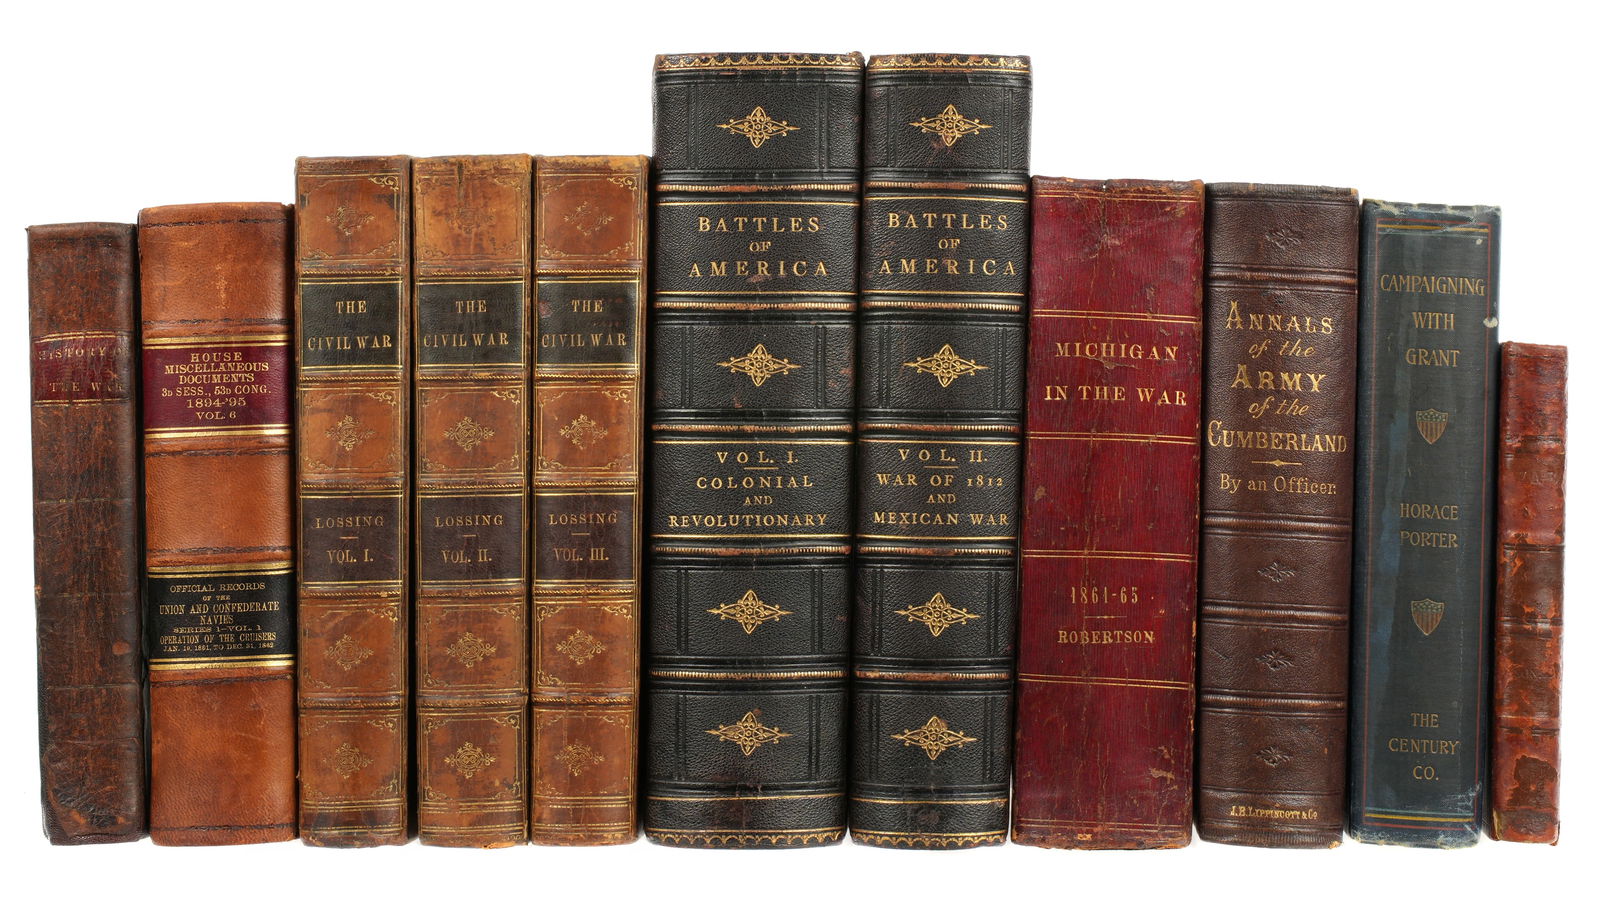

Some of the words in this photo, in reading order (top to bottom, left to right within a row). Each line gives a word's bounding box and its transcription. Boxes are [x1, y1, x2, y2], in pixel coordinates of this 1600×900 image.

[699, 217, 820, 232] BATTLES
[888, 212, 1008, 230] BATTLES
[750, 241, 772, 252] OF
[938, 238, 960, 249] OF
[689, 261, 829, 277] AMERICA
[879, 258, 1016, 276] AMERICA
[1380, 274, 1485, 296] CAMPAIGNING
[336, 301, 366, 314] THE
[456, 300, 487, 313] THE
[572, 300, 603, 313] THE
[1412, 312, 1455, 330] WITH
[308, 335, 351, 350] CIVIL
[357, 335, 392, 349] WAR
[424, 334, 467, 348] CIVIL
[473, 333, 509, 346] WAR
[541, 334, 585, 348] CIVIL
[591, 333, 627, 347] WAR
[1055, 342, 1178, 361] MICHIGAN
[1248, 339, 1271, 359] of
[1279, 339, 1315, 357] the
[191, 352, 242, 362] HOUSE
[1406, 348, 1460, 367] GRANT
[165, 362, 269, 374] MISCELLANEOUS
[179, 373, 254, 384] DOCUMENTS
[176, 386, 211, 397] SESS.,
[235, 384, 271, 394] CONG.
[1044, 385, 1068, 400] IN
[1078, 386, 1125, 401] THE
[1137, 387, 1186, 406] WAR
[1248, 396, 1274, 419] of
[1274, 398, 1309, 416] the
[196, 412, 225, 420] VOL.
[716, 451, 774, 464] VOL.
[787, 451, 799, 464] I.
[898, 449, 956, 462] VOL.
[969, 450, 988, 462] II.
[696, 476, 813, 489] COLONIAL
[877, 473, 918, 486] WAR
[930, 474, 954, 486] OF
[967, 474, 1003, 488] 1812
[1220, 473, 1241, 494] By
[1248, 480, 1267, 491] an
[1274, 476, 1337, 495] Officer.
[744, 495, 773, 506] AND
[926, 493, 956, 504] AND
[1400, 503, 1459, 520] HORACE
[315, 516, 384, 529] LOSSING
[434, 515, 503, 527] LOSSING
[549, 513, 618, 525] LOSSING
[668, 513, 827, 528] REVOLUTIONARY
[873, 512, 959, 525] MEXICAN
[970, 513, 1010, 526] WAR
[1400, 530, 1458, 548] PORTER
[327, 549, 356, 564] VOL.
[363, 549, 374, 562] I.
[441, 550, 470, 563] VOL.
[478, 549, 492, 562] II.
[554, 548, 583, 561] VOL.
[589, 548, 609, 560] III.
[170, 585, 215, 593] OFFICIAL
[220, 583, 265, 591] RECORDS
[1071, 586, 1138, 604] 1861-65
[160, 605, 185, 615] UNION
[190, 604, 208, 614] AND
[213, 601, 280, 613] CONFEDERATE
[200, 615, 234, 624] NAVIES
[160, 636, 199, 644] OPERATION
[204, 634, 214, 643] OF
[219, 634, 234, 642] THE
[240, 632, 276, 641] CRUISERS
[1057, 630, 1155, 644] ROBERTSON
[1410, 713, 1440, 728] THE
[1388, 738, 1460, 755] CENTURY
[1413, 766, 1439, 780] CO.
